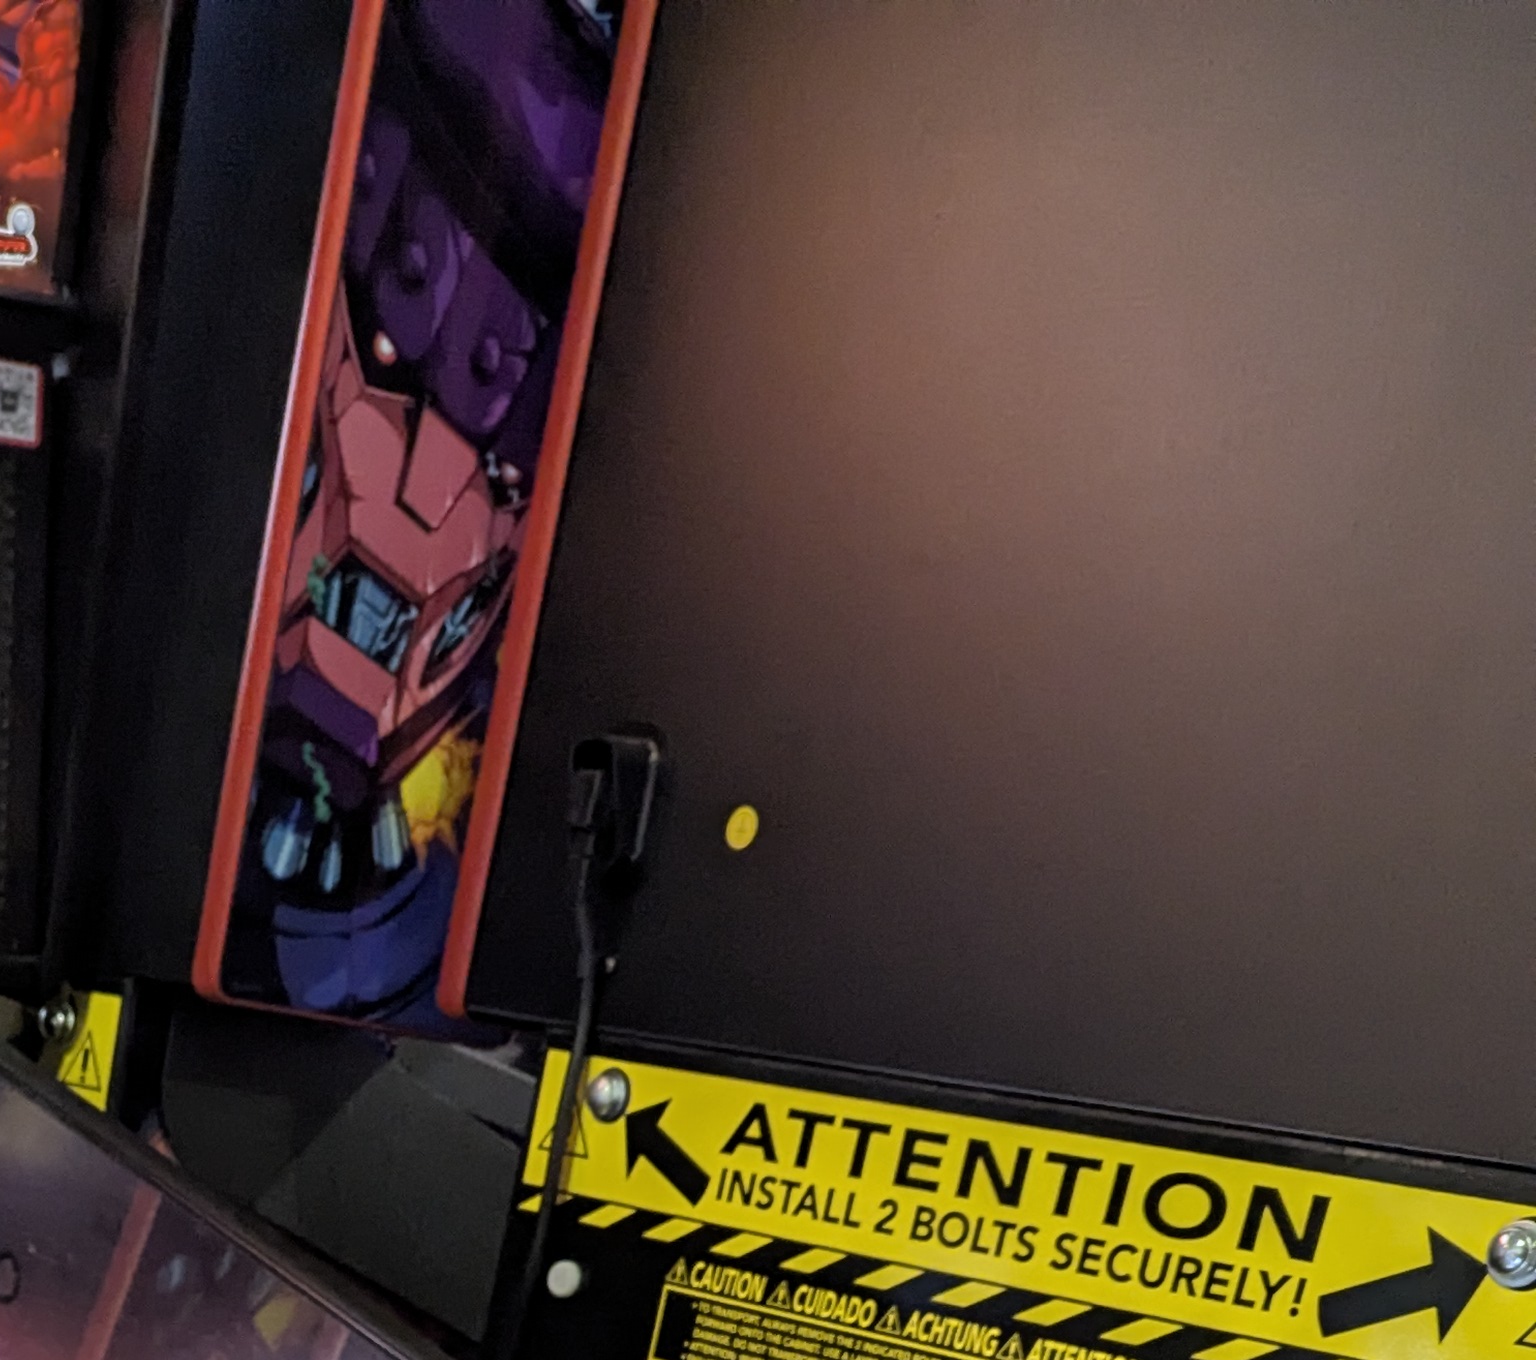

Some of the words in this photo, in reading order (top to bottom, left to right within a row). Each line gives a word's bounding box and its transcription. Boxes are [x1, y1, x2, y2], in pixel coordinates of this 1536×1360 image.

[716, 1166, 862, 1229] INSTALL
[874, 1199, 900, 1235] 2
[910, 1206, 1039, 1264] BOLTS
[1049, 1232, 1308, 1319] SECURELY!
[721, 1102, 1332, 1262] ATTENTION
[688, 1261, 767, 1304] CAUTION
[790, 1284, 878, 1329] CUIDADO
[902, 1310, 1001, 1358] ACHTUNG
